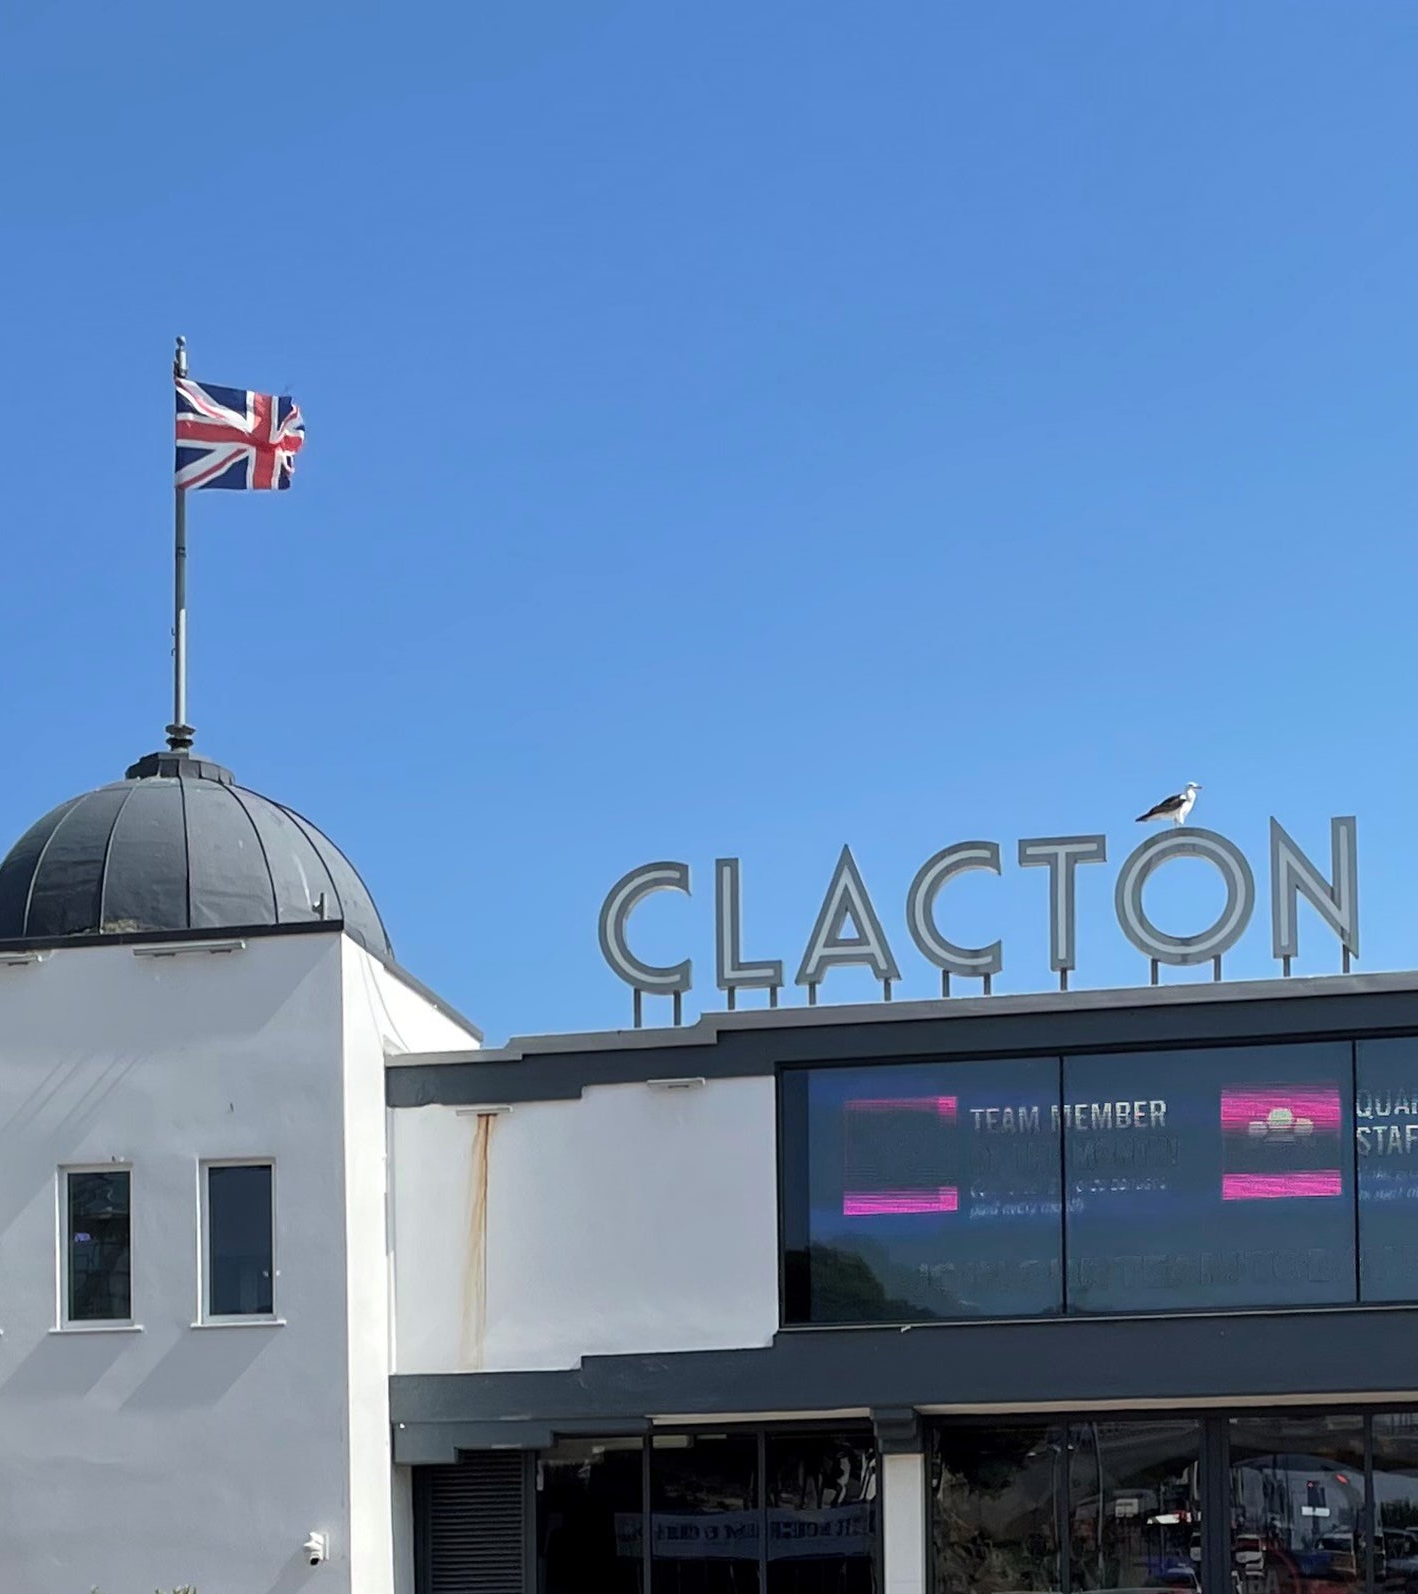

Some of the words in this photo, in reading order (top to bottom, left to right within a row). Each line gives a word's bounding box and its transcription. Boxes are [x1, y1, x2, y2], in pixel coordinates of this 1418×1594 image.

[597, 814, 1360, 996] CLACTON
[968, 1105, 1042, 1135] TEAM
[1050, 1099, 1169, 1132] MEMBER
